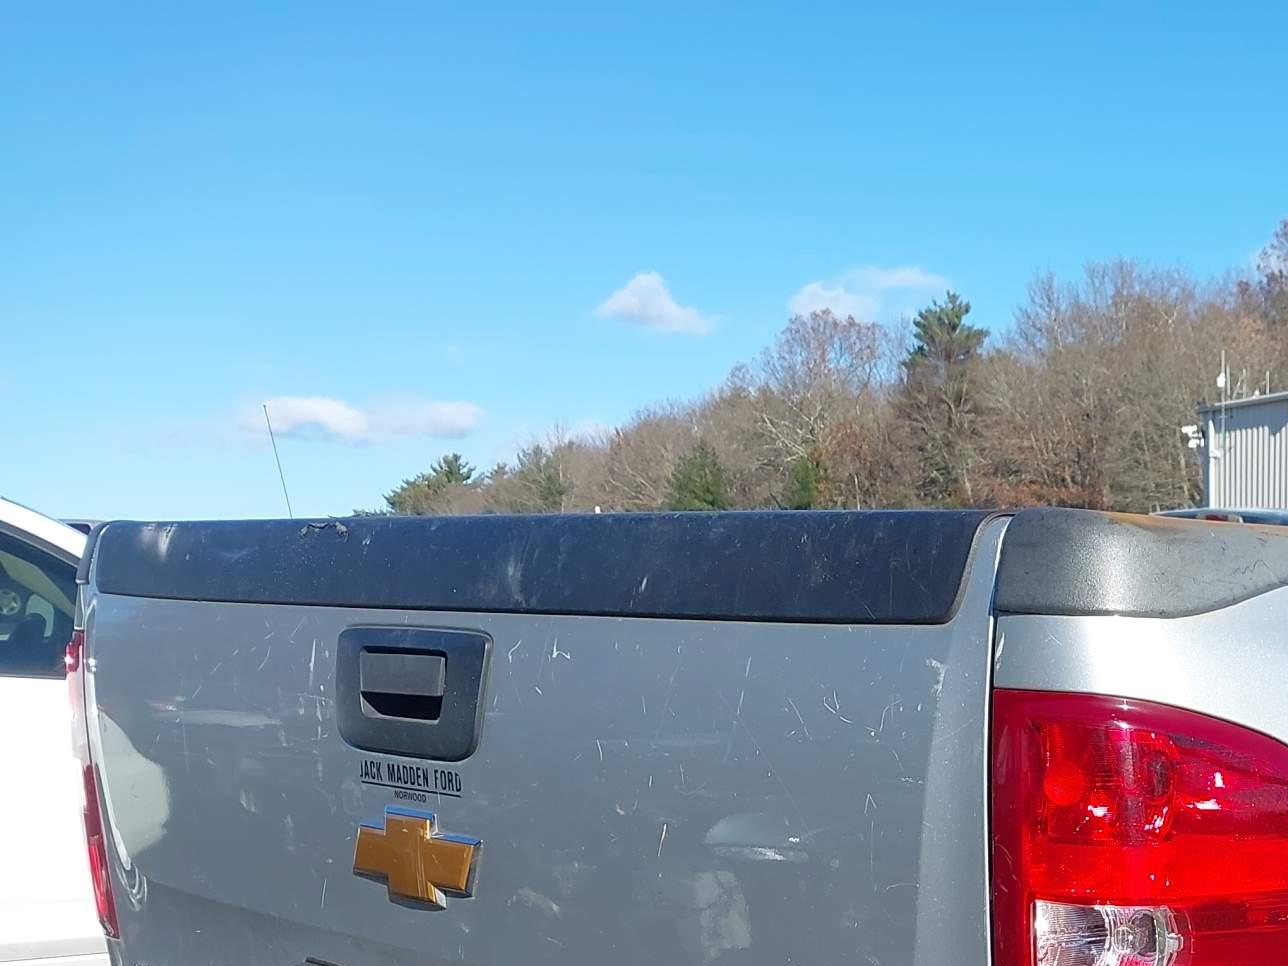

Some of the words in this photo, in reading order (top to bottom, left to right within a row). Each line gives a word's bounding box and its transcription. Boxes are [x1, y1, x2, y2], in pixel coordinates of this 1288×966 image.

[360, 759, 383, 781] JACK
[388, 763, 430, 788] MADDEN
[434, 770, 462, 793] FORD
[395, 790, 427, 803] NORWOOD
